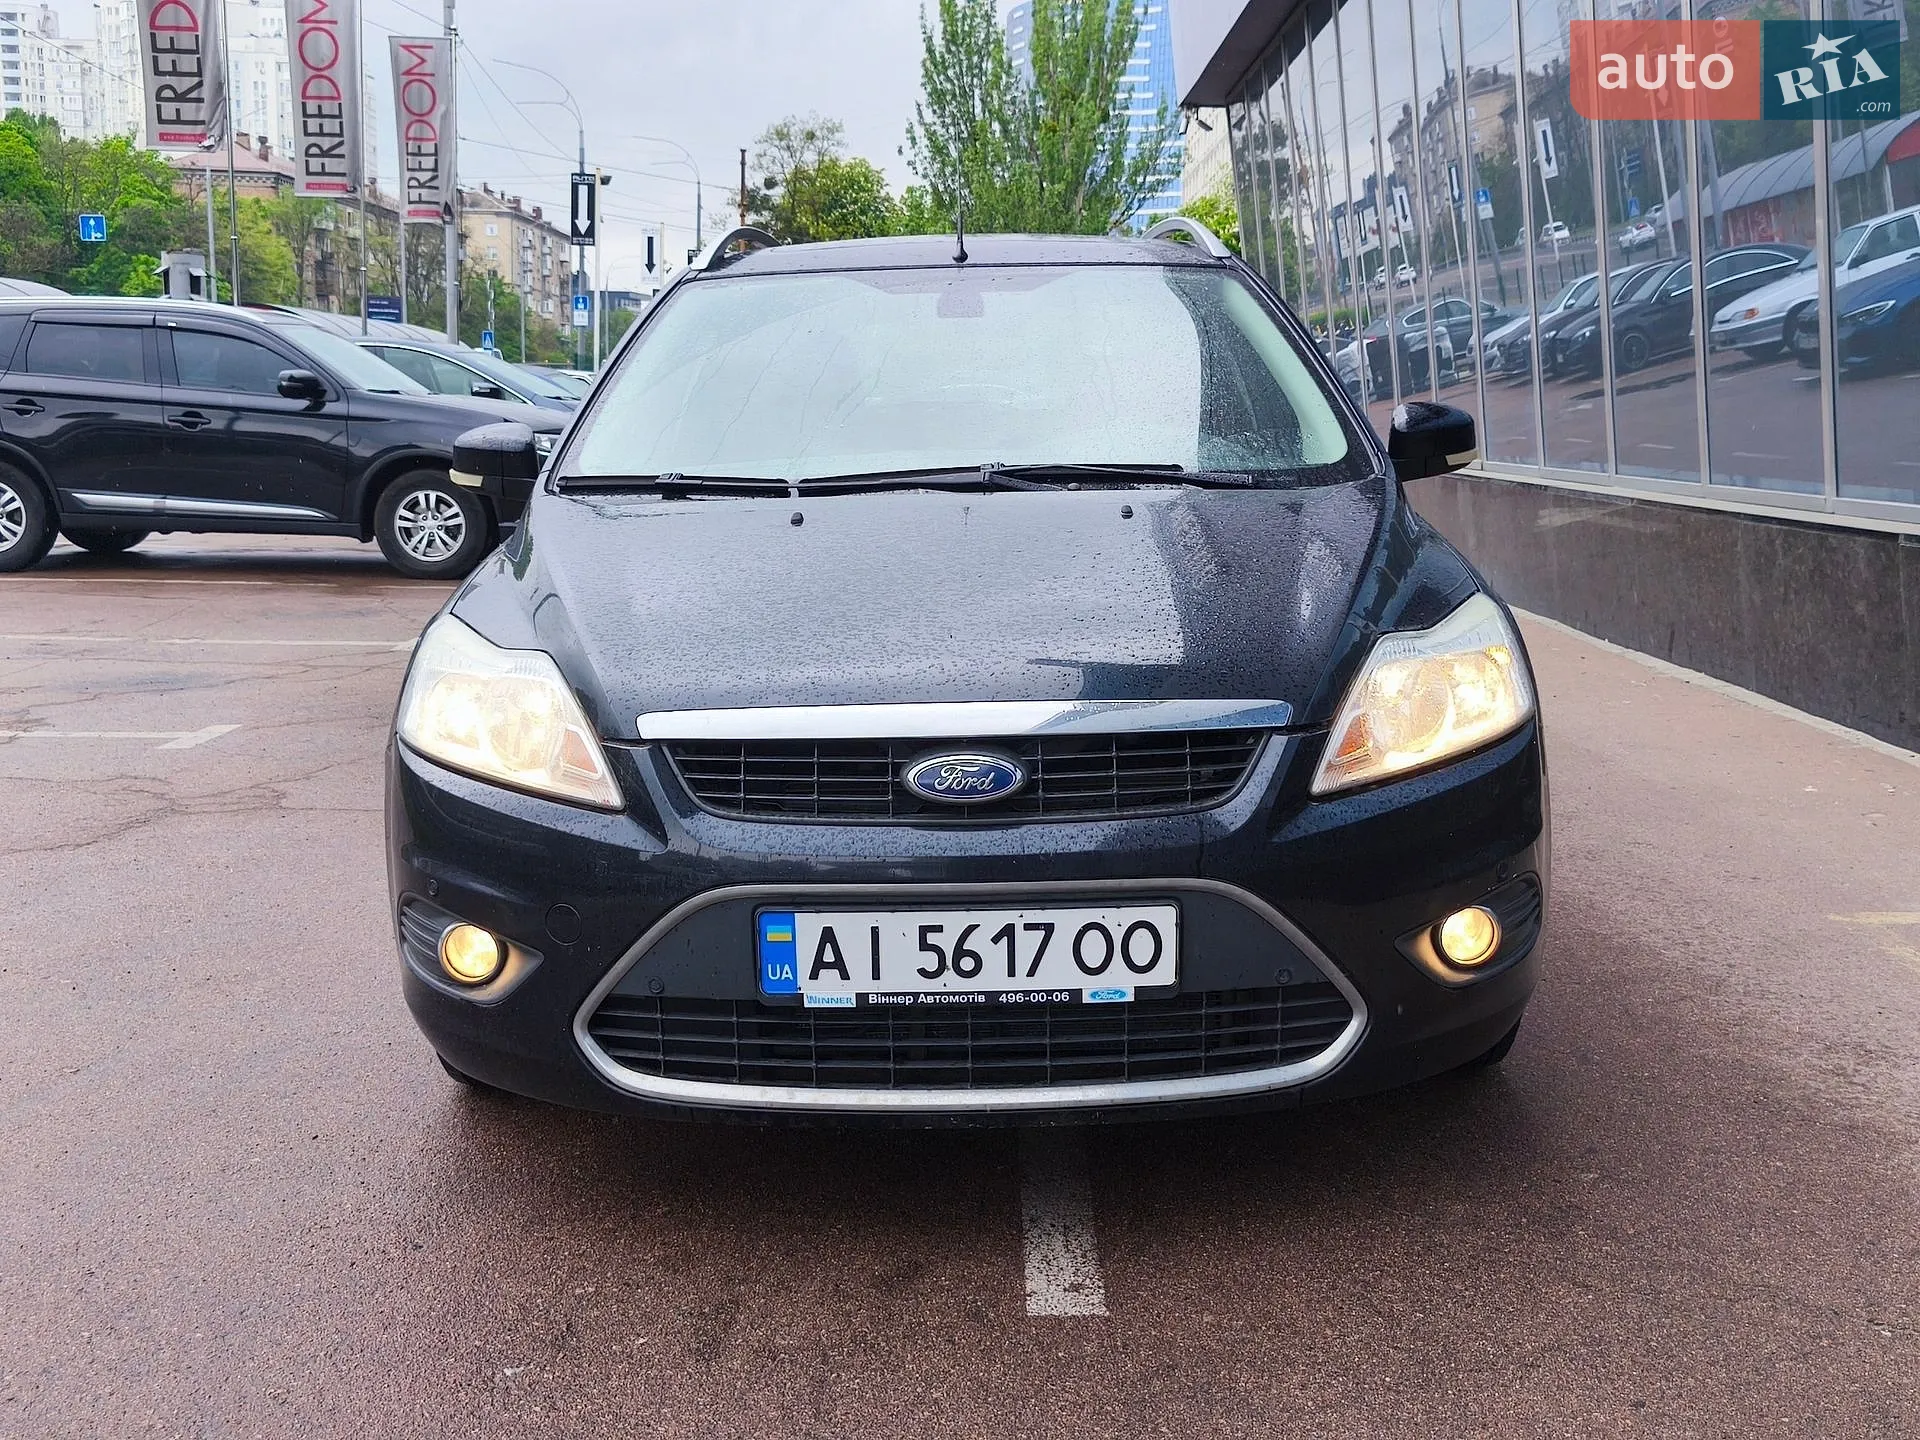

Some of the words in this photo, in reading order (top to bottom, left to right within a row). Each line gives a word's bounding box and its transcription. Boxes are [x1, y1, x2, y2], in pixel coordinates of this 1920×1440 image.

[297, 0, 347, 177] FREEDOM
[400, 44, 440, 205] FREEDOM
[934, 765, 995, 790] Ford
[916, 923, 1055, 979] 5617
[768, 964, 793, 981] UA
[868, 993, 914, 1006] Віннер
[917, 992, 985, 1004] Автомотів
[999, 991, 1070, 1004] 496-00-06
